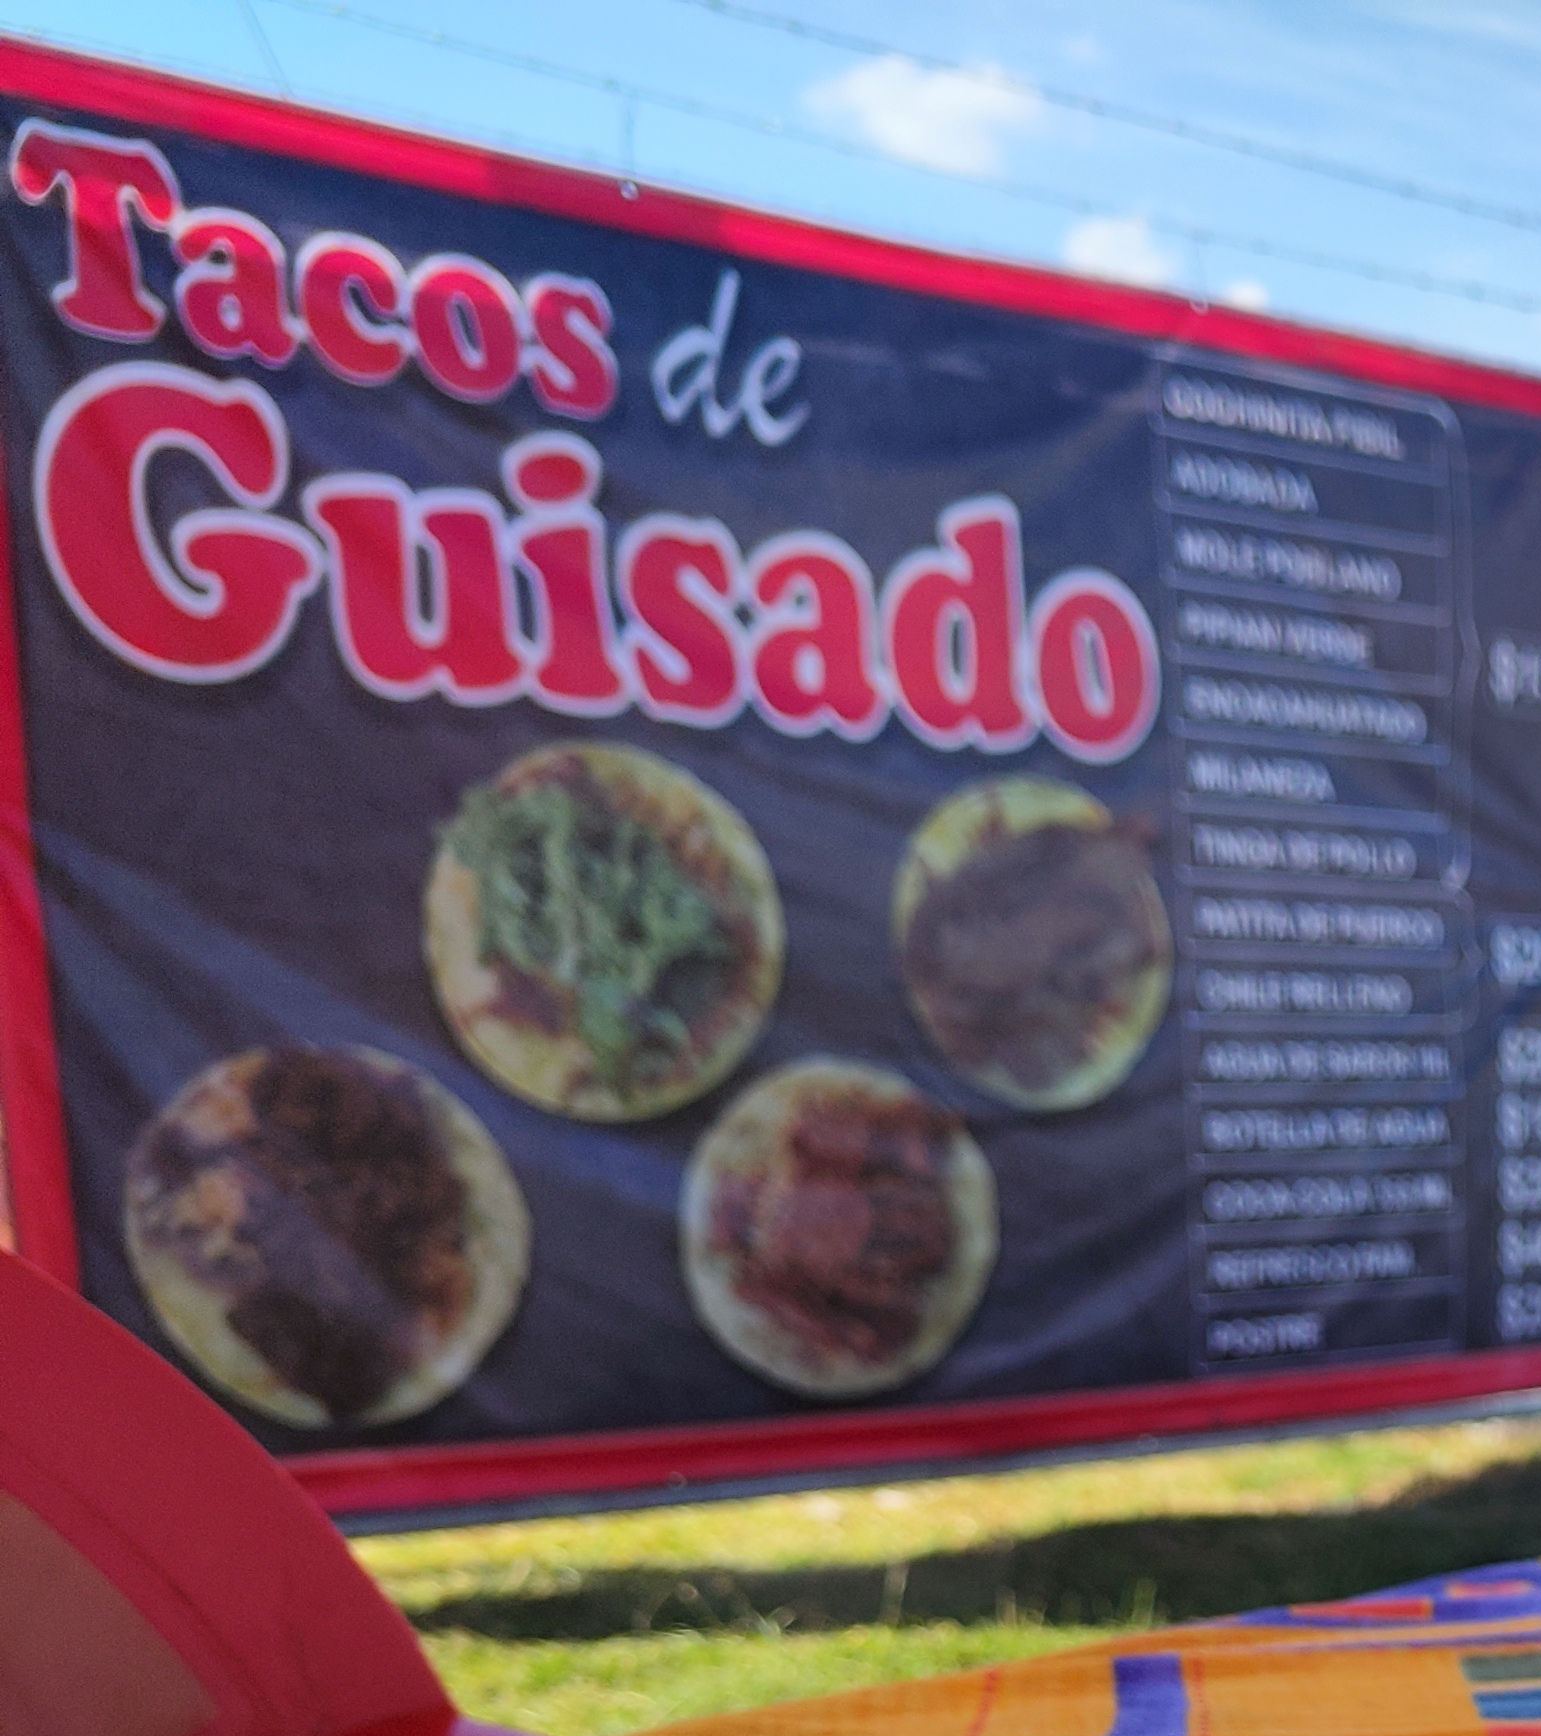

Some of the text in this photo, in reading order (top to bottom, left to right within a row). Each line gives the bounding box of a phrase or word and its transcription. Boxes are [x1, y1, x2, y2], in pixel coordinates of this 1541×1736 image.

[12, 116, 812, 446] Tacos de
[35, 361, 1162, 766] Guisado
